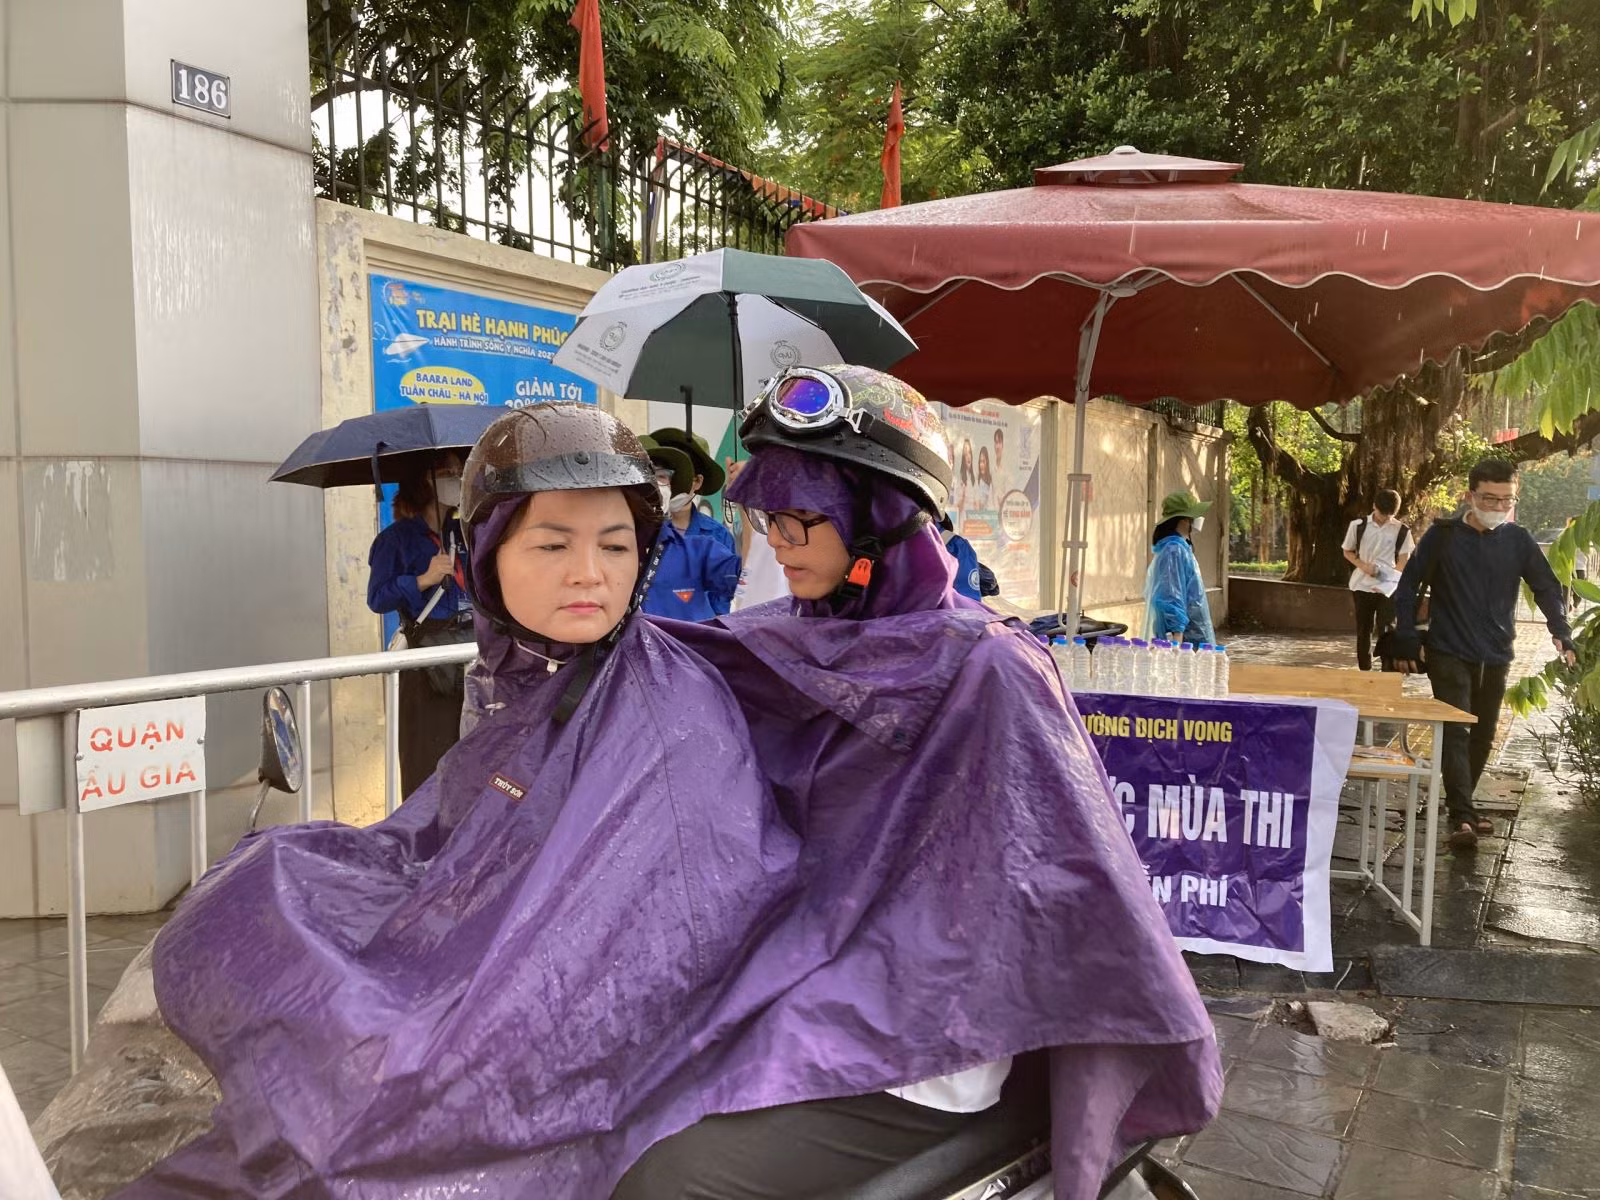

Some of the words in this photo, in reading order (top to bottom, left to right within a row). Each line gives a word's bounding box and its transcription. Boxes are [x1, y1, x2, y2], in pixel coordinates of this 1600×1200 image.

[178, 68, 227, 109] 186
[416, 309, 457, 334] TRẠI
[461, 312, 481, 334] HÈ
[485, 317, 529, 340] HẠNH
[434, 336, 458, 347] HÀNH
[460, 337, 482, 349] TRÌNH
[416, 373, 449, 385] BAARA
[451, 377, 473, 387] LAND
[428, 388, 451, 399] CHÂU
[516, 376, 555, 397] GIẢM
[559, 382, 582, 402] TỚI
[1081, 710, 1130, 737] ƯỜNG
[1135, 717, 1178, 743] DỊCH
[1183, 719, 1232, 745] VỌNG
[1148, 774, 1228, 843] MÙA
[1240, 788, 1294, 849] THI
[1181, 874, 1229, 907] PHÍ
